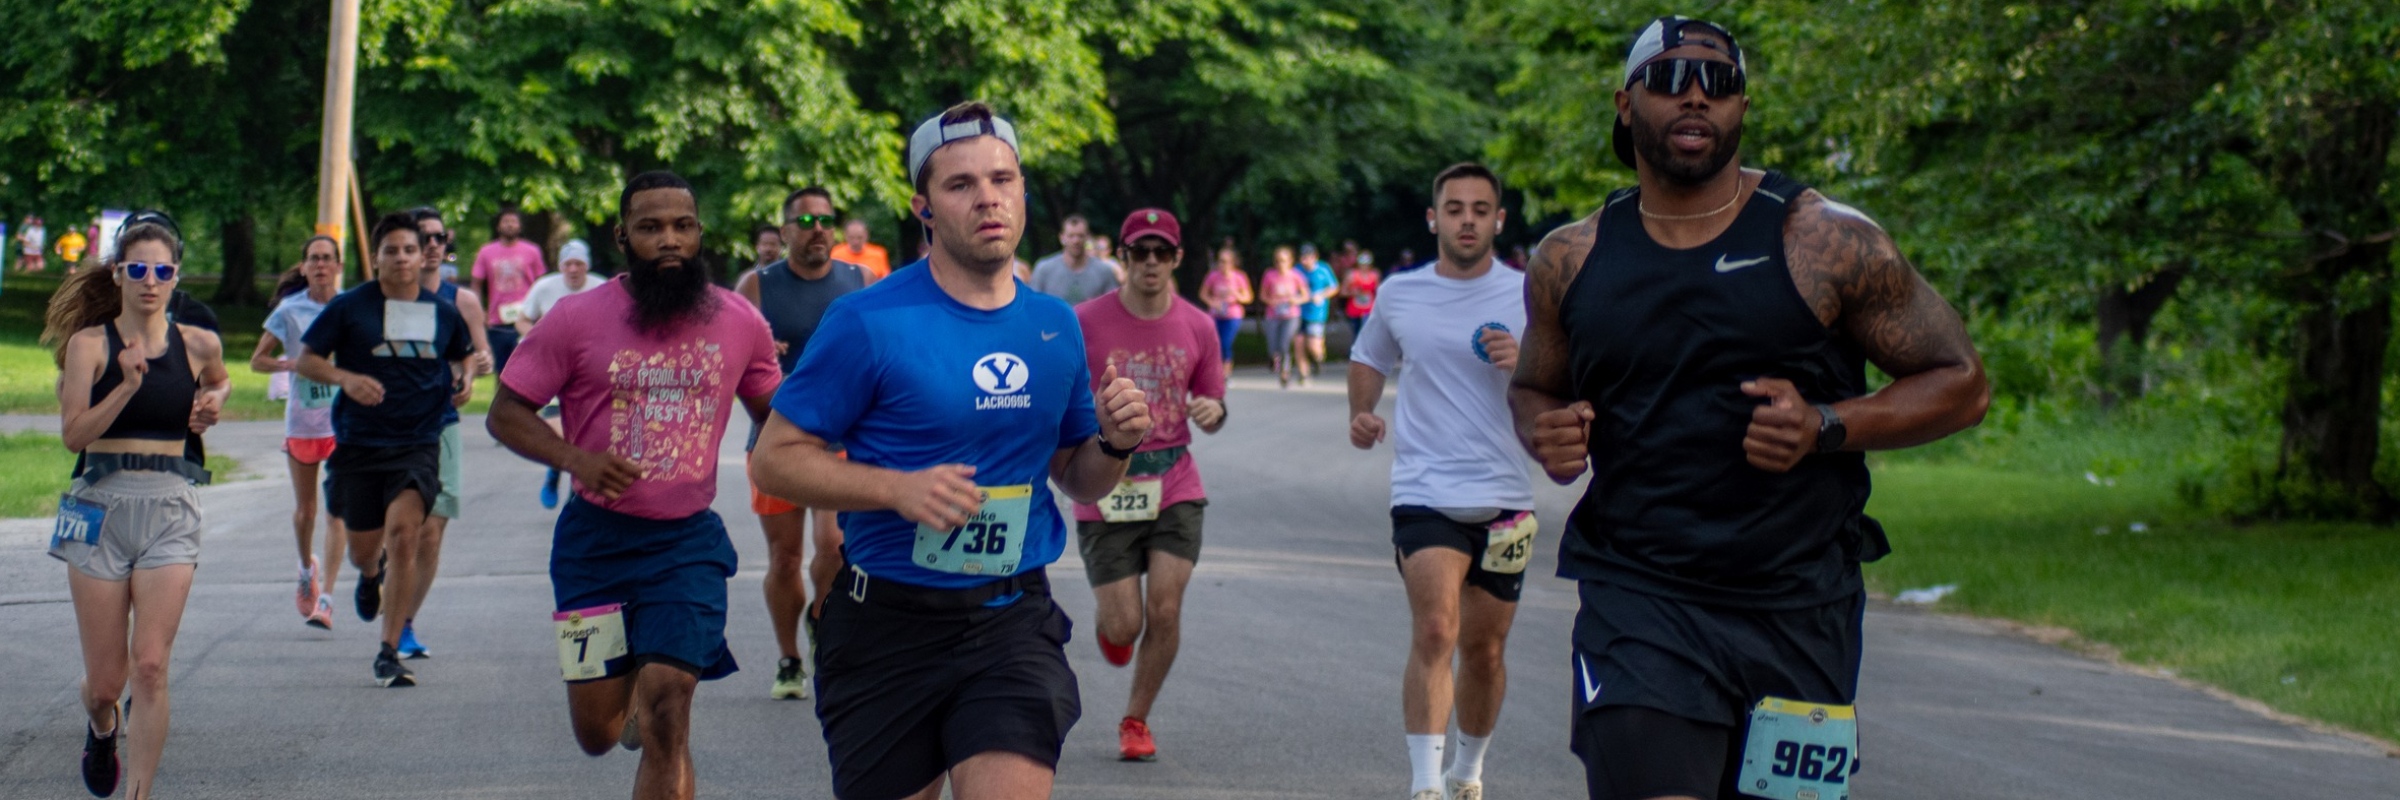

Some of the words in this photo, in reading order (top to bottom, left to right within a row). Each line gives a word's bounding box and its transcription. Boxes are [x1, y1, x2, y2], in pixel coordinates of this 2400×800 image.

[638, 368, 703, 387] PHILLY
[980, 357, 1019, 390] Y
[647, 387, 684, 403] RUN
[975, 394, 1031, 411] LACROSSE
[644, 404, 689, 423] FEST
[1111, 494, 1149, 511] 323
[57, 515, 88, 541] 170
[560, 626, 600, 639] Joseph
[573, 635, 589, 664] 7
[1771, 740, 1848, 785] 962
